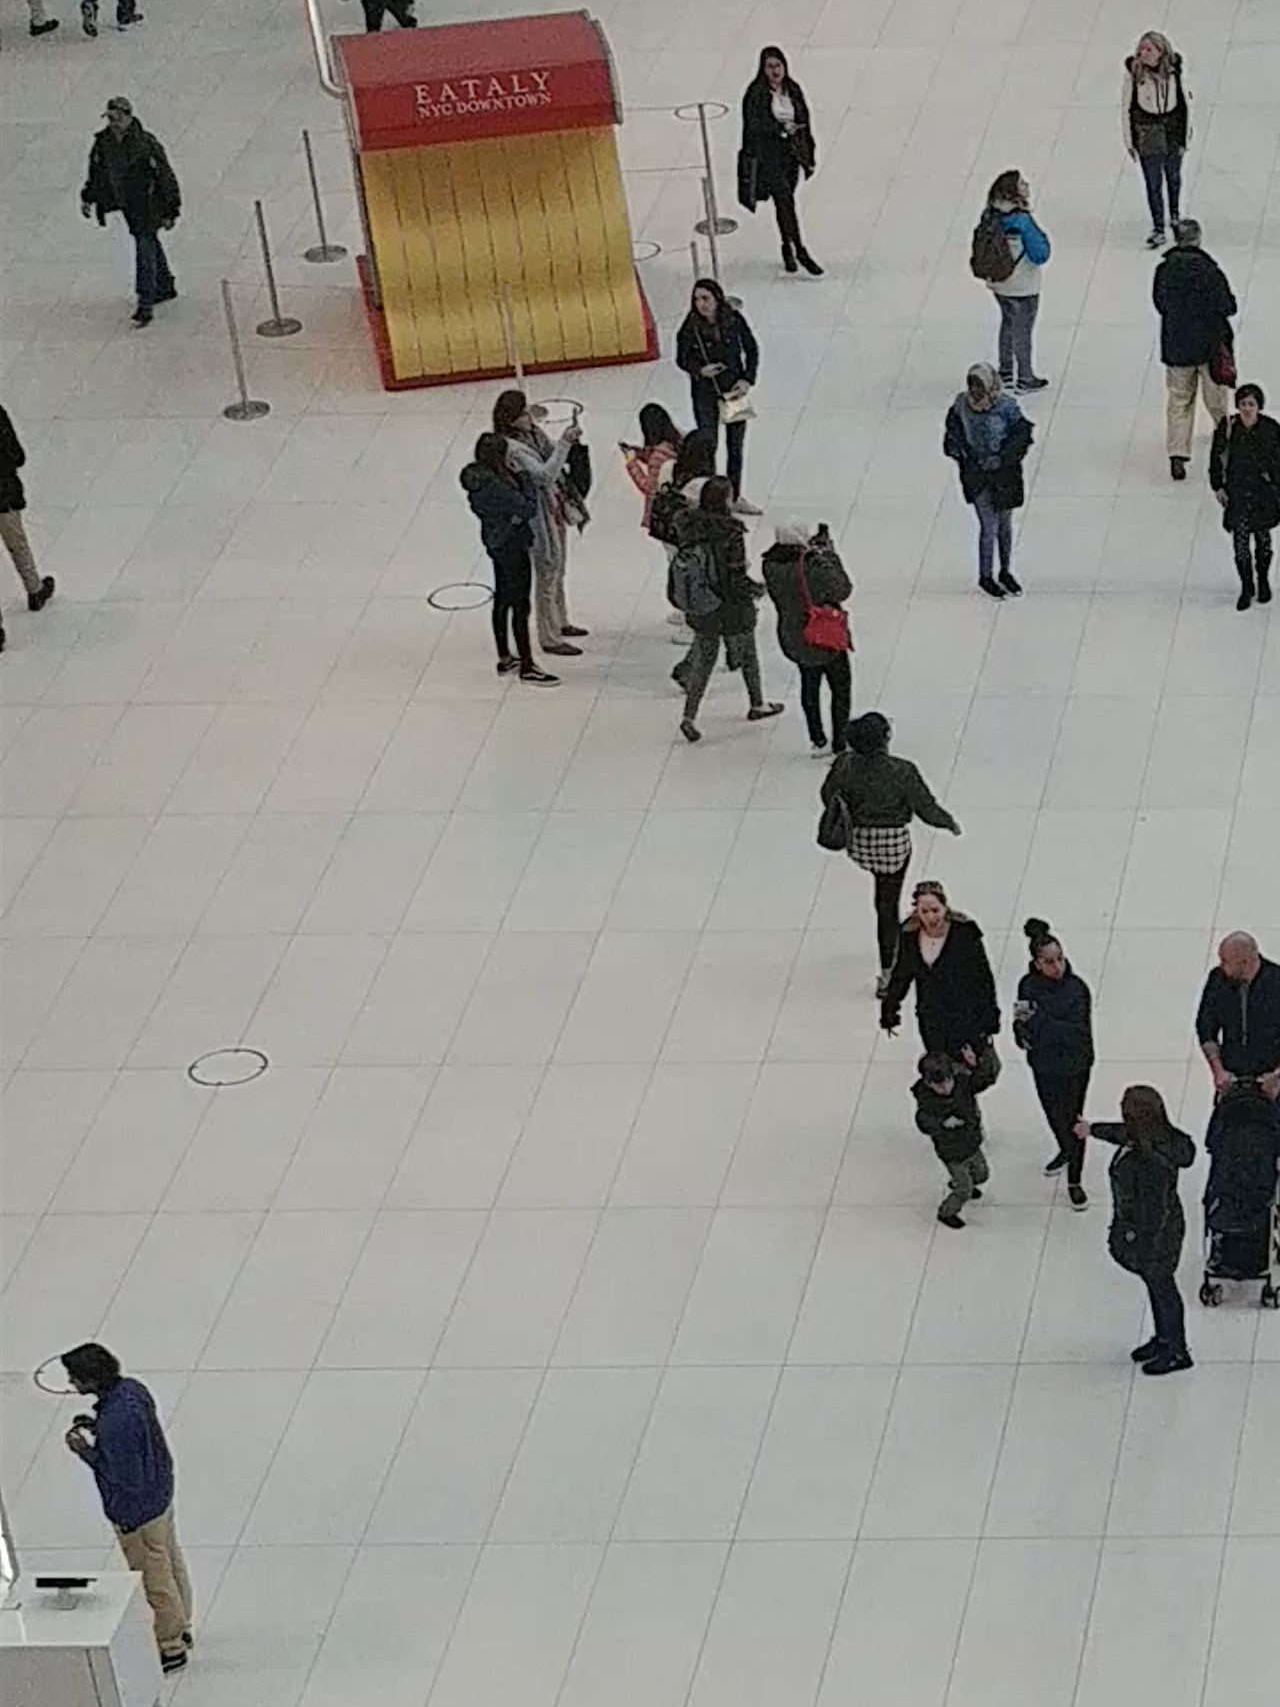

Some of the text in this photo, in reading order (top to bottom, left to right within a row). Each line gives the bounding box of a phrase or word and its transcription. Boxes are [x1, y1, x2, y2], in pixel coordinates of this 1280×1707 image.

[414, 71, 549, 105] EATALY
[417, 91, 552, 118] NYC DOWNTOWN
